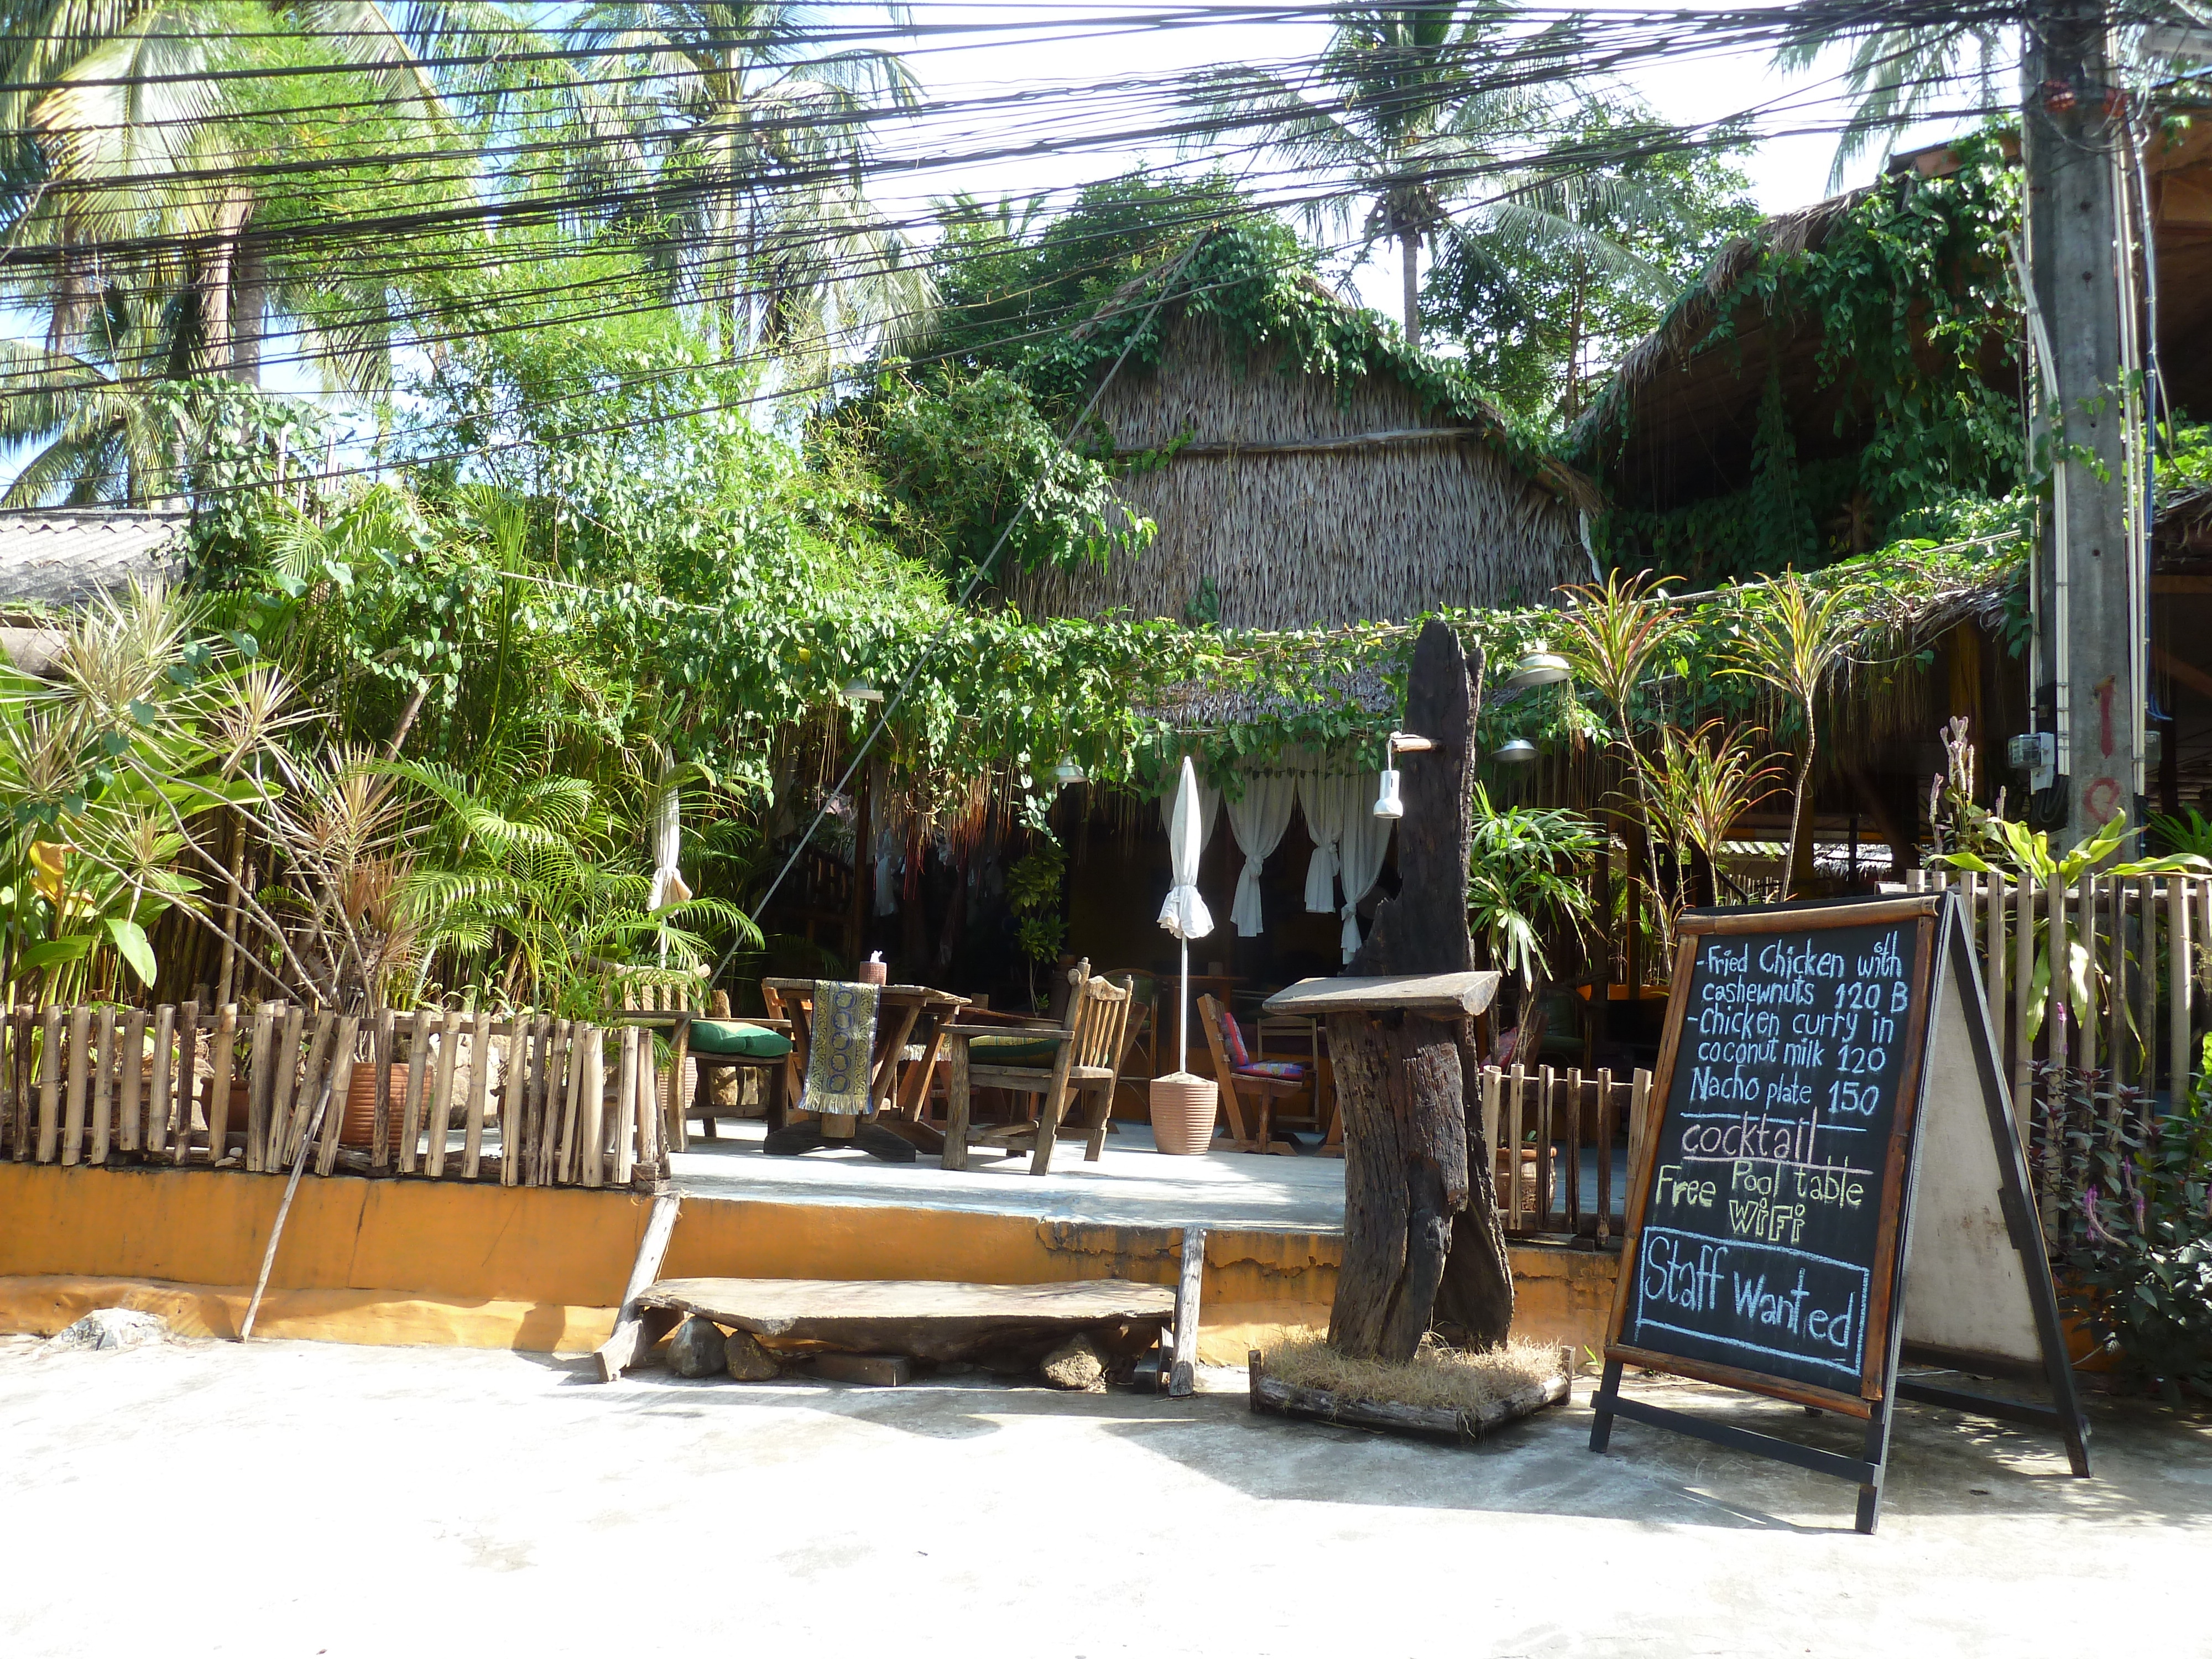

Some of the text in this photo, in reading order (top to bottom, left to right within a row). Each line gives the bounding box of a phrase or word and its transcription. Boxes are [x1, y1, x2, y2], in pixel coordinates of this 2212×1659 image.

[1760, 938, 1844, 979] Chicken
[1858, 931, 1902, 978] with
[1703, 974, 1908, 1013] cashewnuts 120 B
[1793, 1010, 1858, 1043] curry
[1872, 1011, 1893, 1044] in
[1698, 1037, 1886, 1073] coconut milk 120
[1689, 1064, 1879, 1116] Nacho plate 150
[1656, 1155, 1864, 1209] Free Pool table
[1645, 1237, 1857, 1348] Staff Wanted
